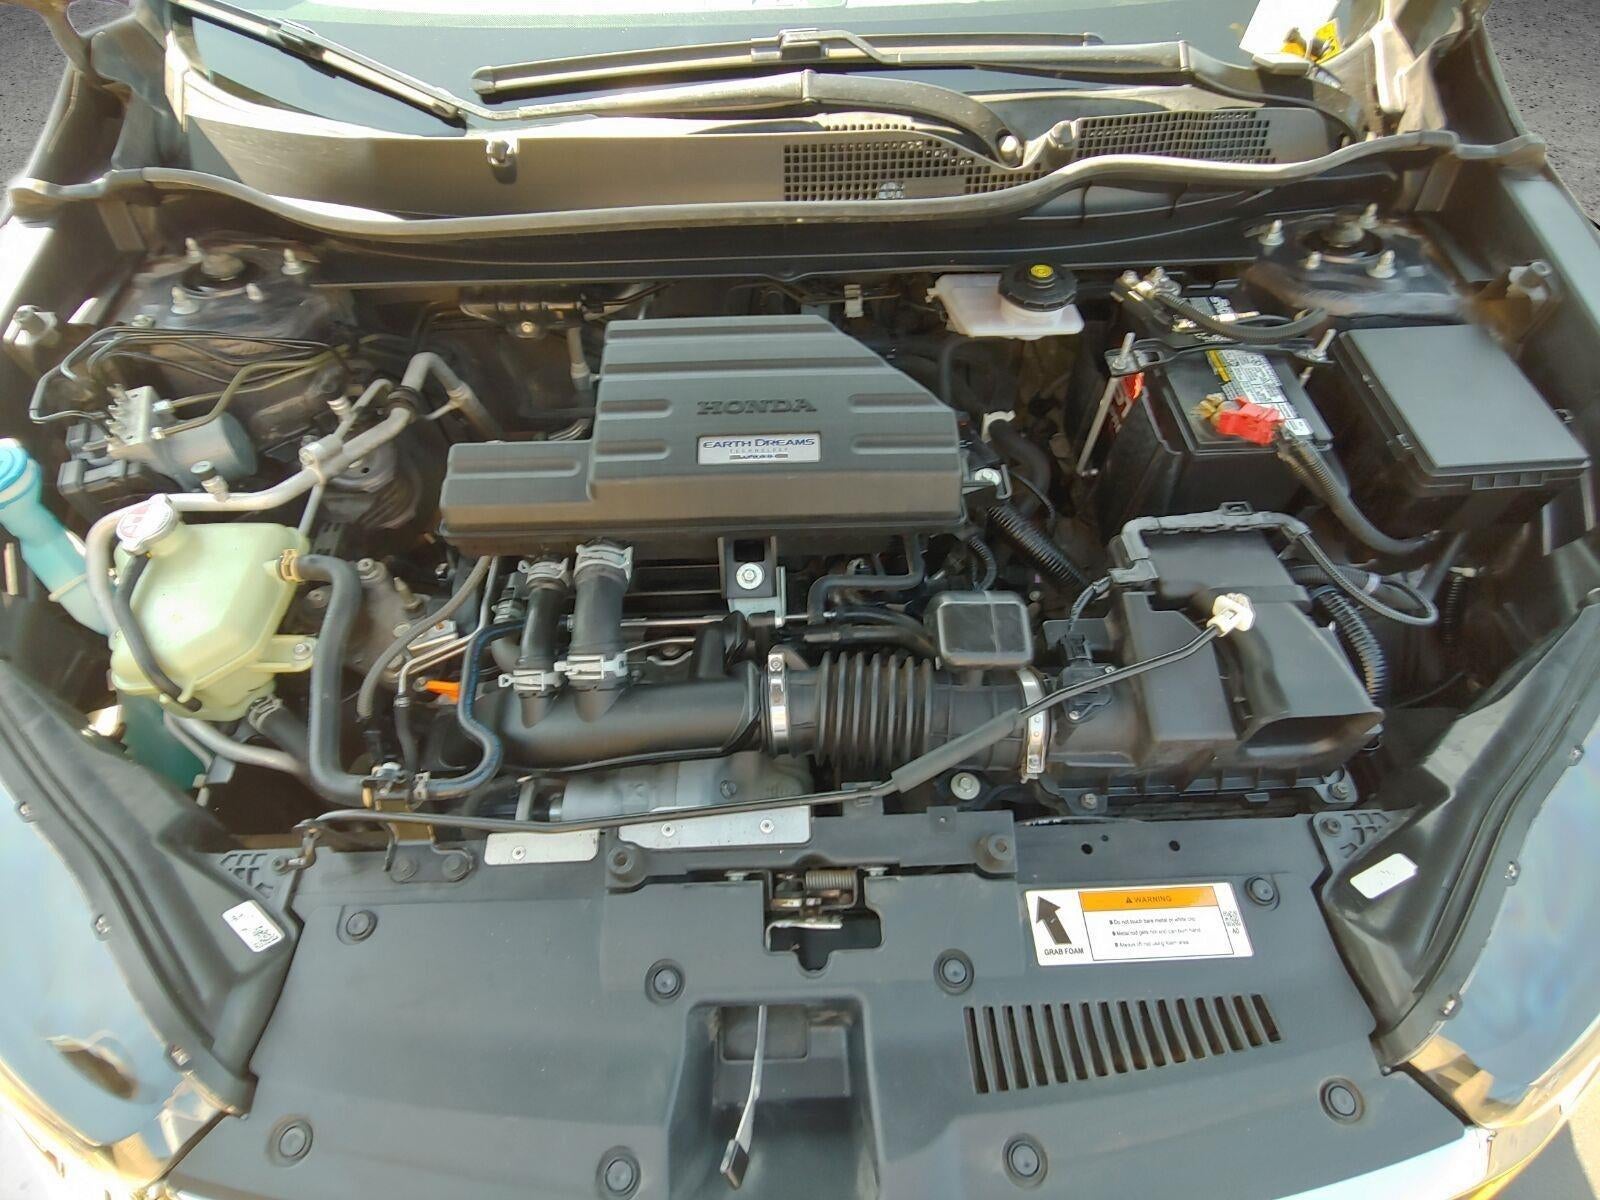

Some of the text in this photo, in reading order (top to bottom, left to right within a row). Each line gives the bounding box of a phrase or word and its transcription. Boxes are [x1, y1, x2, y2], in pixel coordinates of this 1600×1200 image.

[697, 398, 818, 415] HONDA
[703, 438, 815, 449] EARTH DREAMS
[1134, 895, 1172, 904] WARNING
[1064, 947, 1084, 955] FOAM
